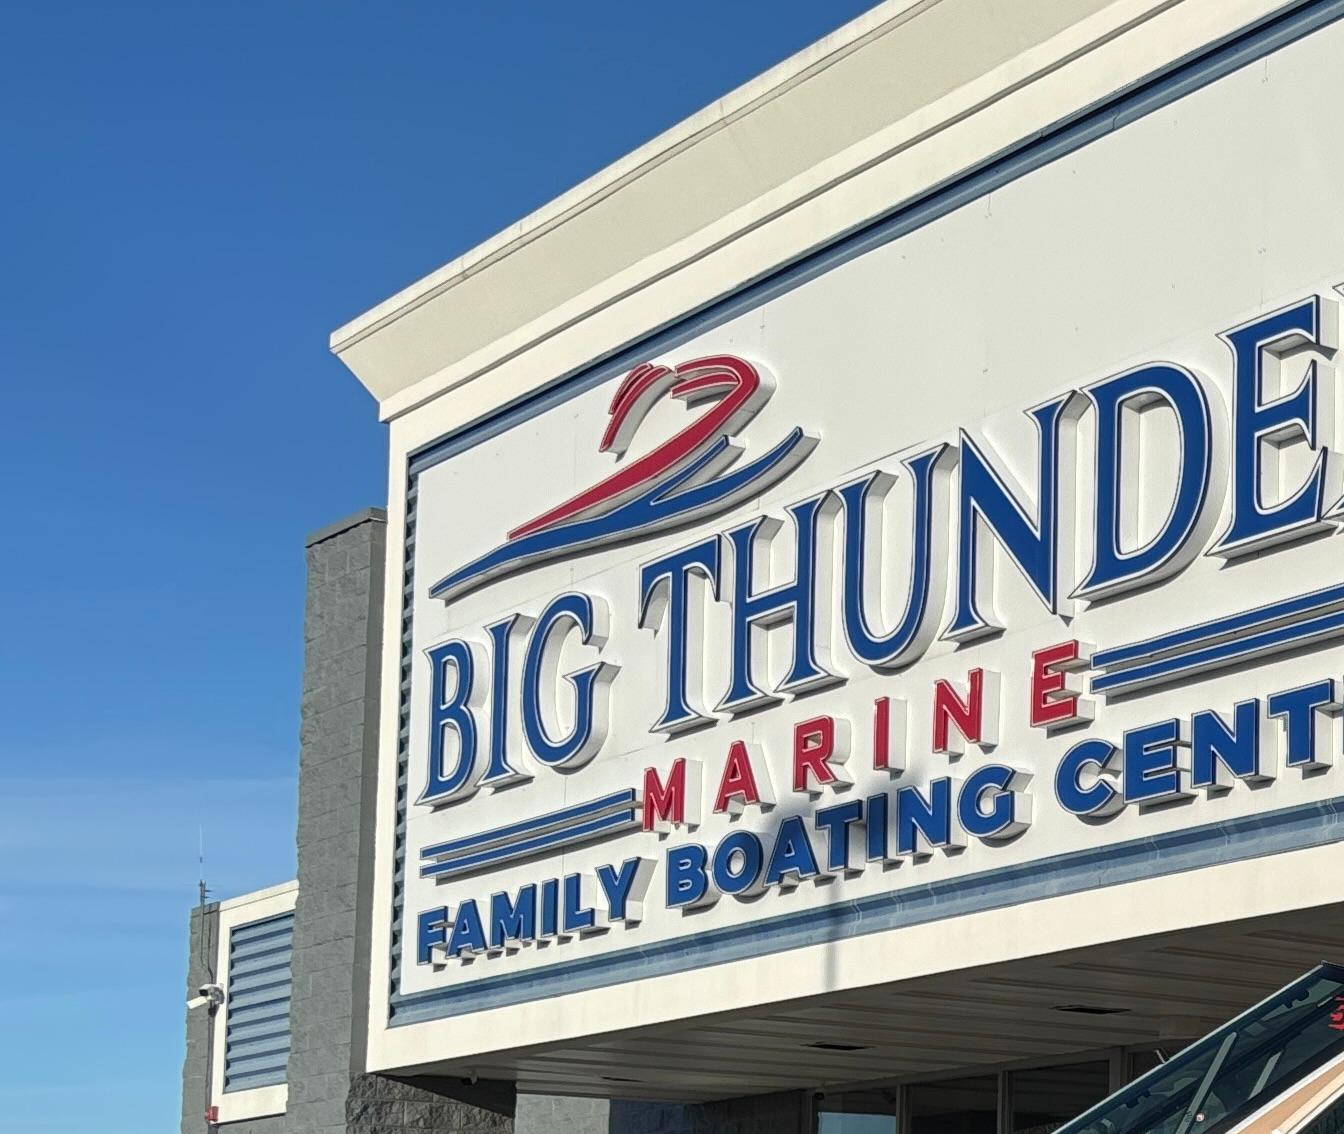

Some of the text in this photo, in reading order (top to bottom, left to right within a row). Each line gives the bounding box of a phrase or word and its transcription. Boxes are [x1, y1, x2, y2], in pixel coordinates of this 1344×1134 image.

[416, 593, 606, 806] BIG
[644, 641, 1082, 830] MARINE
[416, 858, 641, 965] FAMILY
[665, 764, 1017, 909] BOATING
